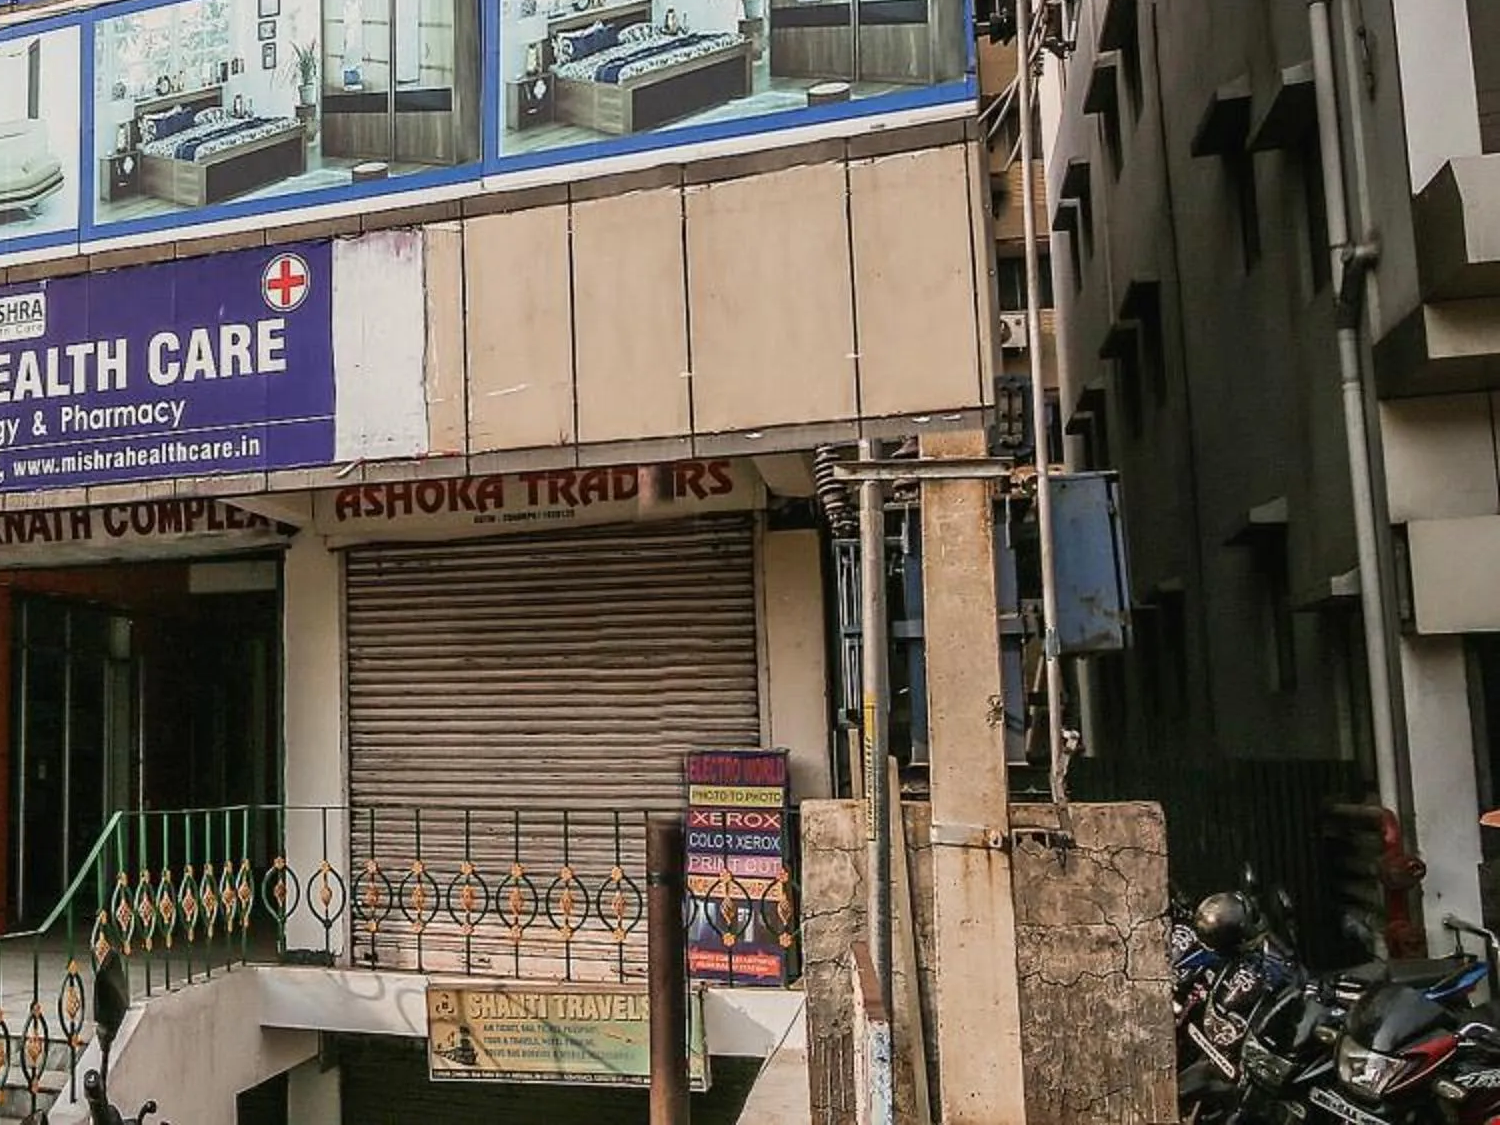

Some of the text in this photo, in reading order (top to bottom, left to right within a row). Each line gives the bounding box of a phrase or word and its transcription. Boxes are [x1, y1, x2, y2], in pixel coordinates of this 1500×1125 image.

[147, 317, 288, 386] CARE
[32, 411, 48, 435] &
[61, 397, 185, 432] Pharmacy
[14, 436, 261, 478] www.mishrahealthcare.in
[335, 460, 733, 521] ASHOKA TRADRS
[745, 792, 781, 803] PHOTO
[692, 810, 780, 828] XEROX
[689, 832, 781, 850] COLOR XEROX
[688, 856, 781, 874] PRINT OUT
[470, 993, 550, 1020] SHANTI
